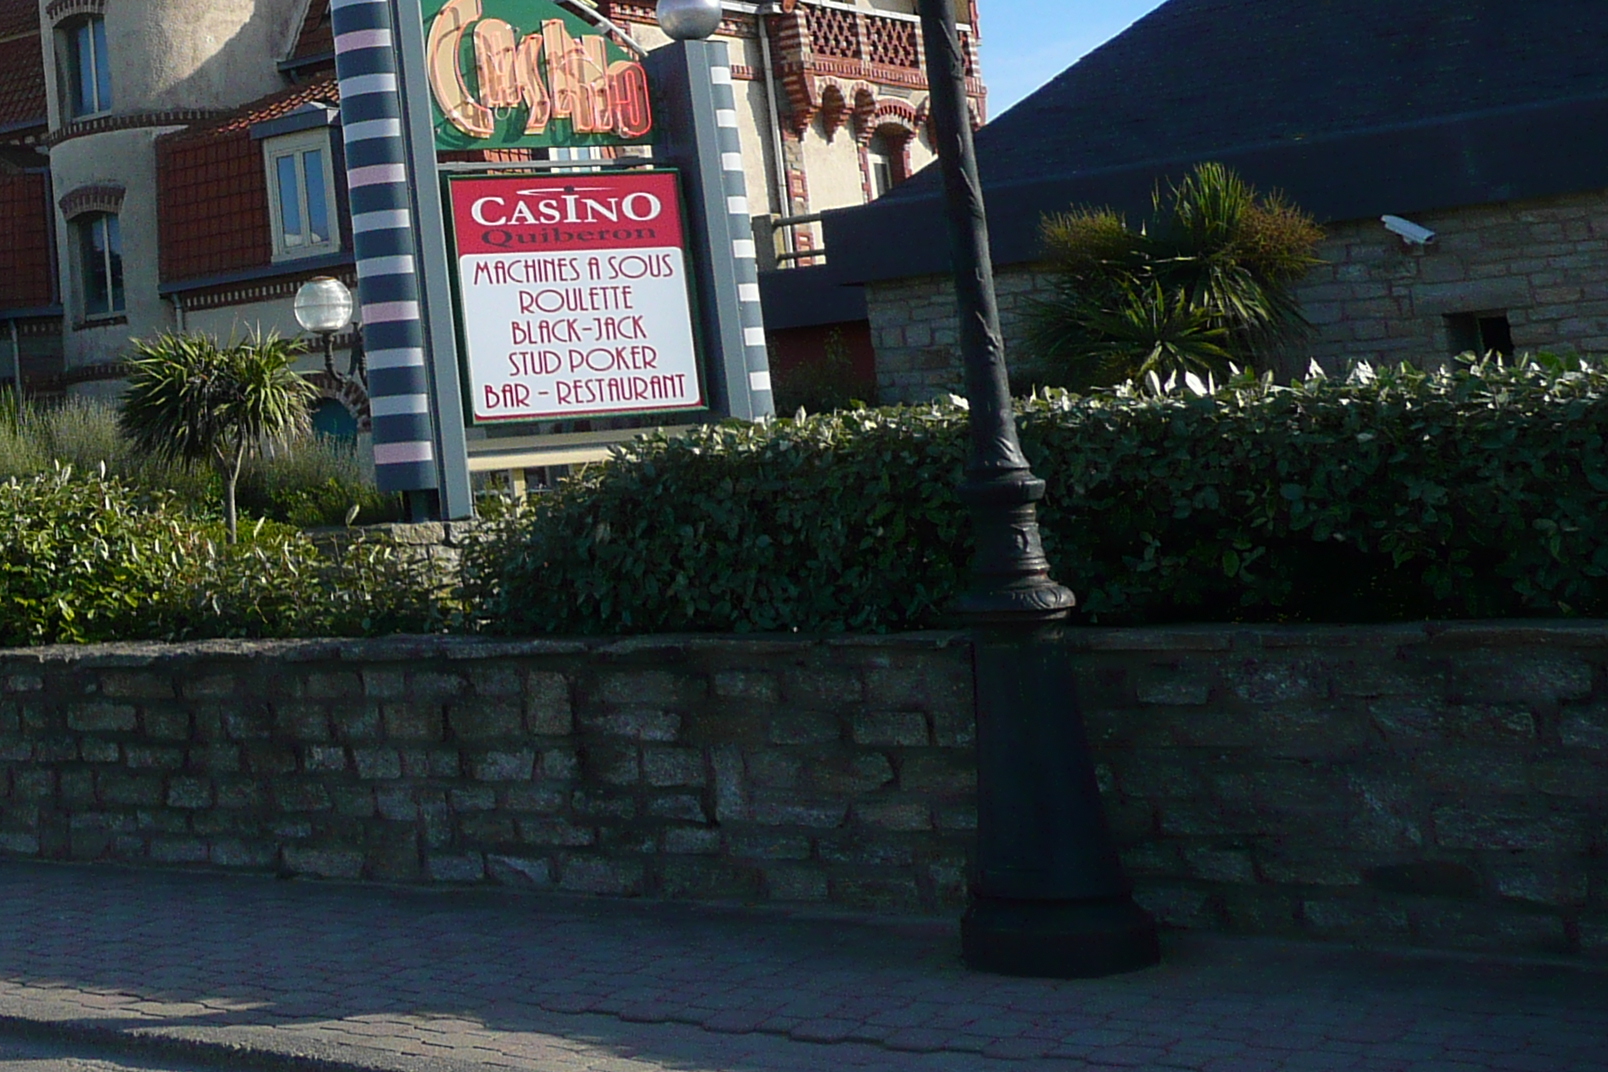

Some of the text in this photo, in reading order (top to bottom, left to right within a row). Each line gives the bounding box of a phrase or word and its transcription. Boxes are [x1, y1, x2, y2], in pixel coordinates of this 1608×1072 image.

[471, 191, 662, 226] CASINO
[481, 227, 657, 248] Quiberon
[473, 257, 581, 285] MACHINES
[608, 253, 674, 279] SOUS
[518, 285, 633, 314] ROULETTE
[511, 315, 647, 345] BLACK-JACK
[508, 345, 657, 377] STUD POKER
[484, 383, 530, 409] BAR
[556, 374, 686, 405] RESTAURANT
